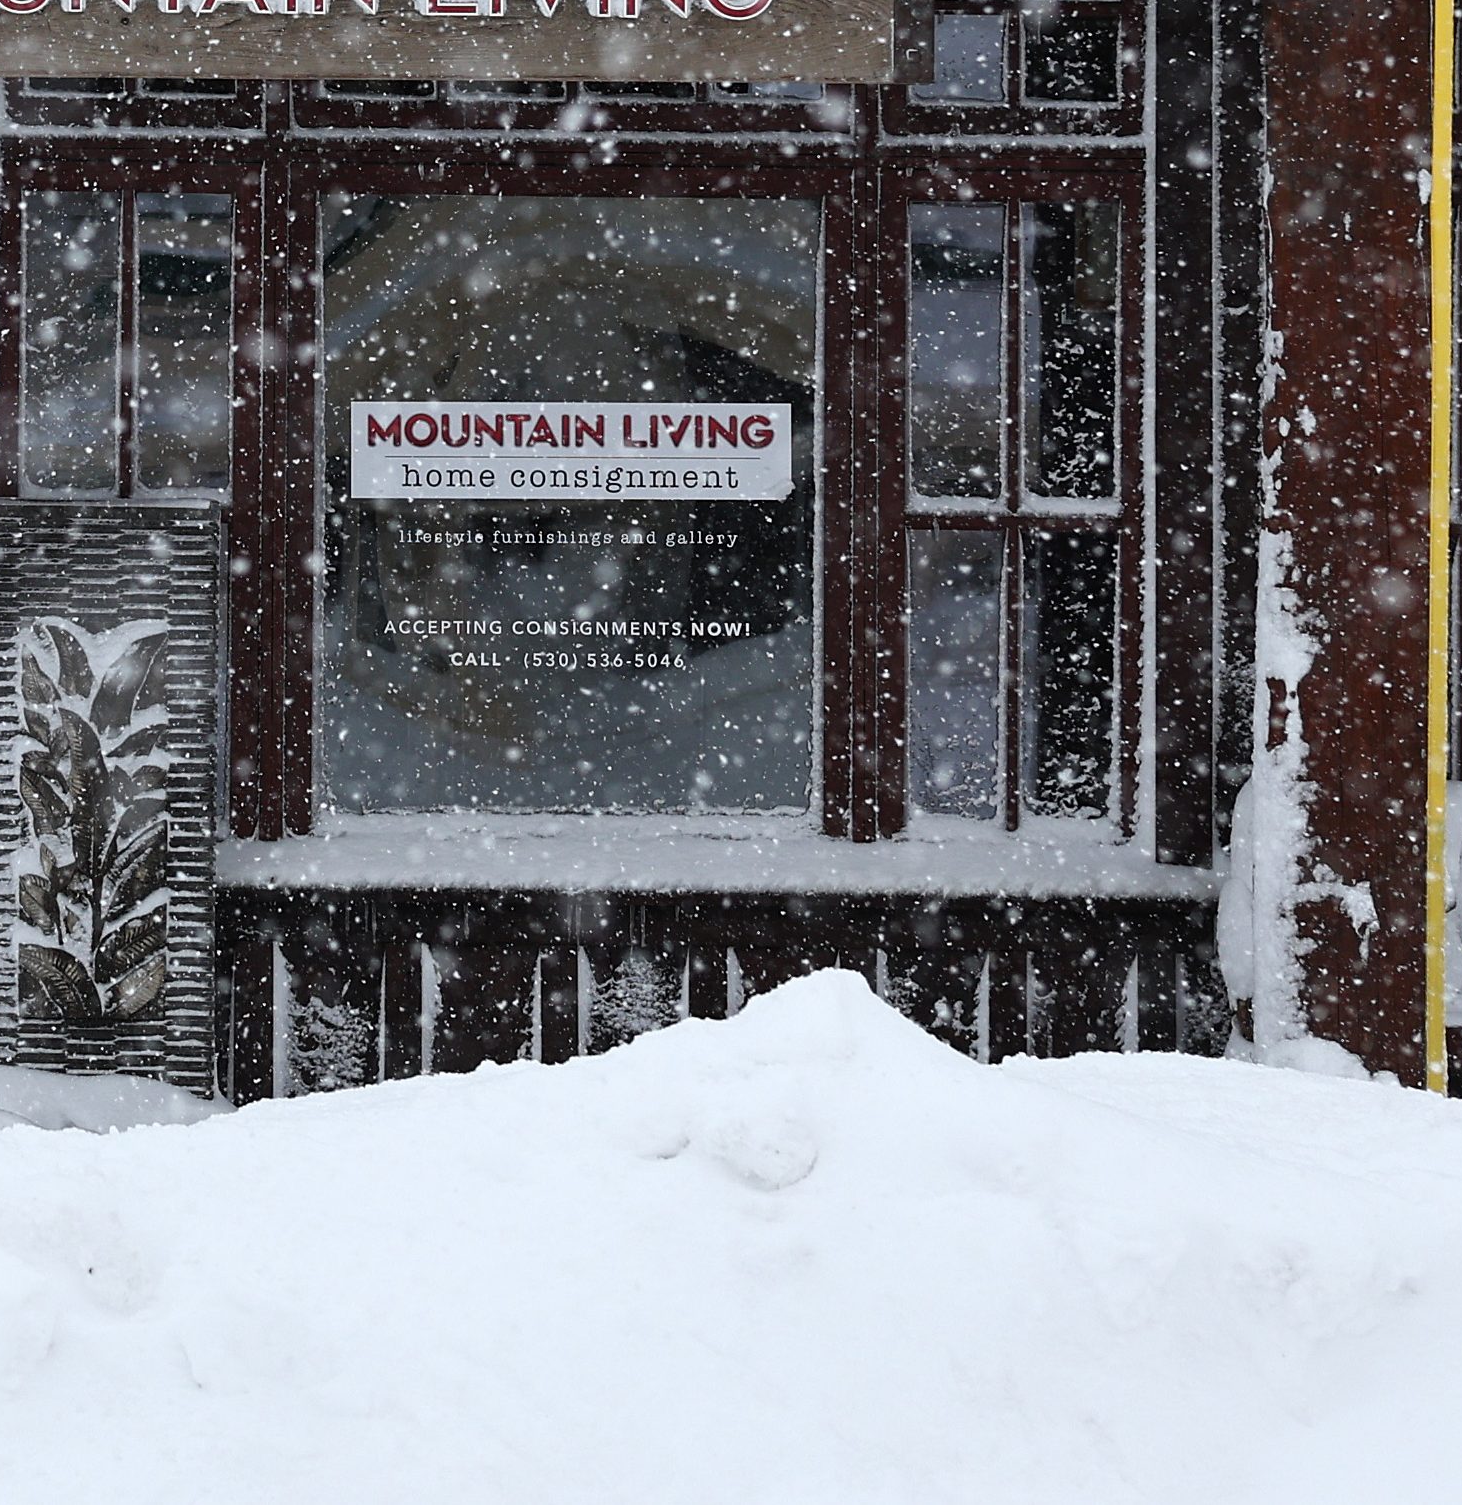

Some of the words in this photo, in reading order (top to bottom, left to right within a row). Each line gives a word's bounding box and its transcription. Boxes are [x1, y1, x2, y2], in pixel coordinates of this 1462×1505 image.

[366, 413, 605, 448] MOUNTAIN
[623, 414, 775, 449] LIVING
[402, 464, 495, 488] home
[510, 464, 739, 493] consignment
[398, 530, 483, 546] lifestyle
[492, 530, 611, 546] furnishings
[620, 531, 656, 545] and
[665, 530, 738, 547] gallery
[384, 620, 503, 636] ACCEPTING
[512, 620, 682, 636] CONSIGNMENTS
[691, 621, 751, 637] NOW!
[523, 652, 578, 669] (530)
[586, 652, 685, 668] 536-5046
